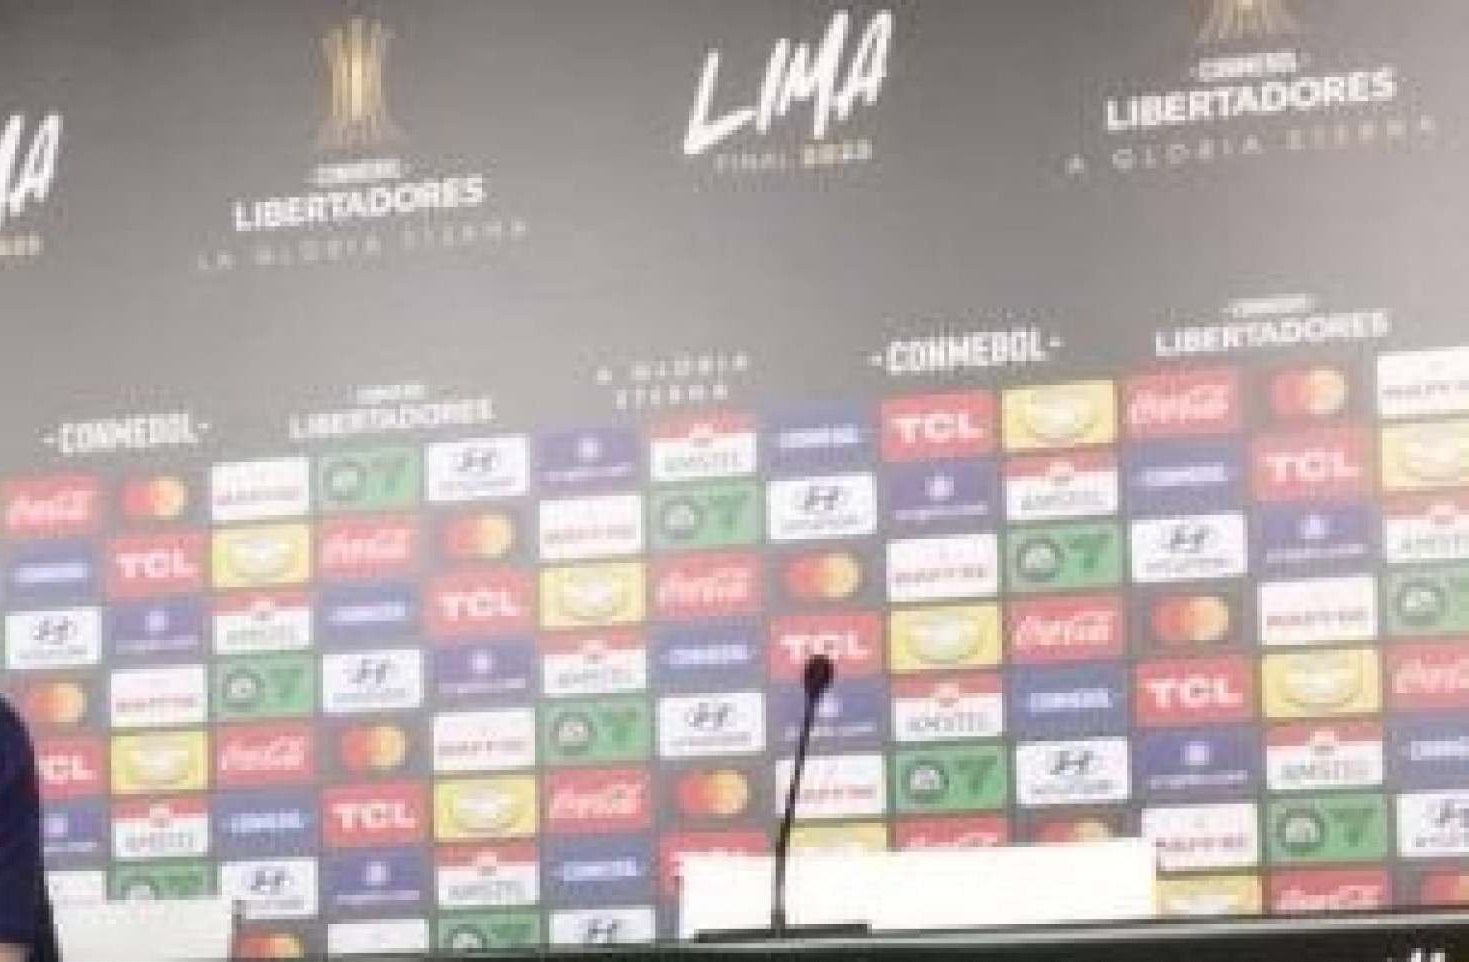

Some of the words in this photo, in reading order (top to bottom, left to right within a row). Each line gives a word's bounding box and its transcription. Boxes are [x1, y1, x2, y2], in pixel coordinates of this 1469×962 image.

[683, 9, 891, 155] LIMA
[1105, 66, 1399, 132] LIBERTADORES
[234, 175, 485, 231] LIBERTADORES
[1155, 309, 1391, 357] LIBERTADORES
[892, 411, 984, 444] TCL
[1261, 450, 1361, 484] TCL
[117, 548, 197, 579] TCL
[440, 589, 520, 621] TCL
[1147, 675, 1243, 709] TCL
[334, 800, 417, 831] TCL
